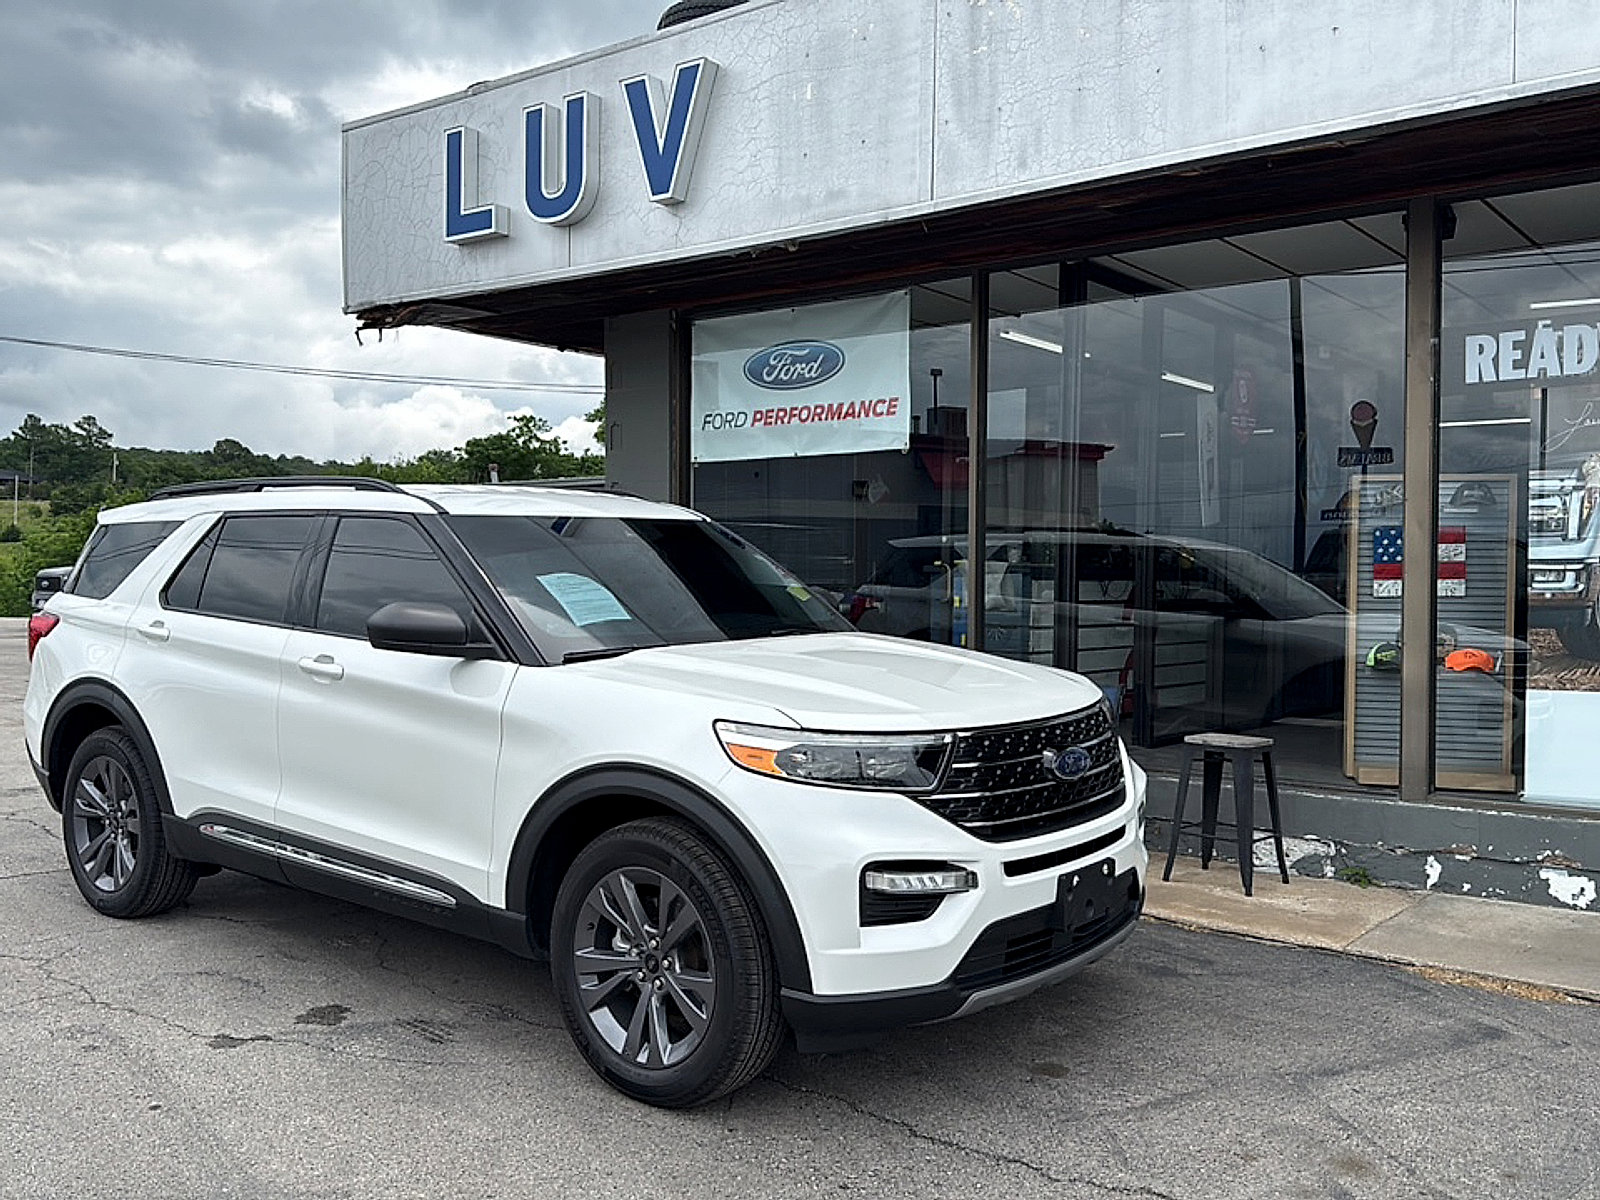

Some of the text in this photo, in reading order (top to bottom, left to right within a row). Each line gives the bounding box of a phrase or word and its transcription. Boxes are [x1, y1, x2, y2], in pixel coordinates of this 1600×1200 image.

[444, 57, 719, 242] LUV
[763, 348, 825, 382] Ford
[1465, 321, 1600, 384] READ
[702, 397, 899, 432] FORD PERFORMANCE
